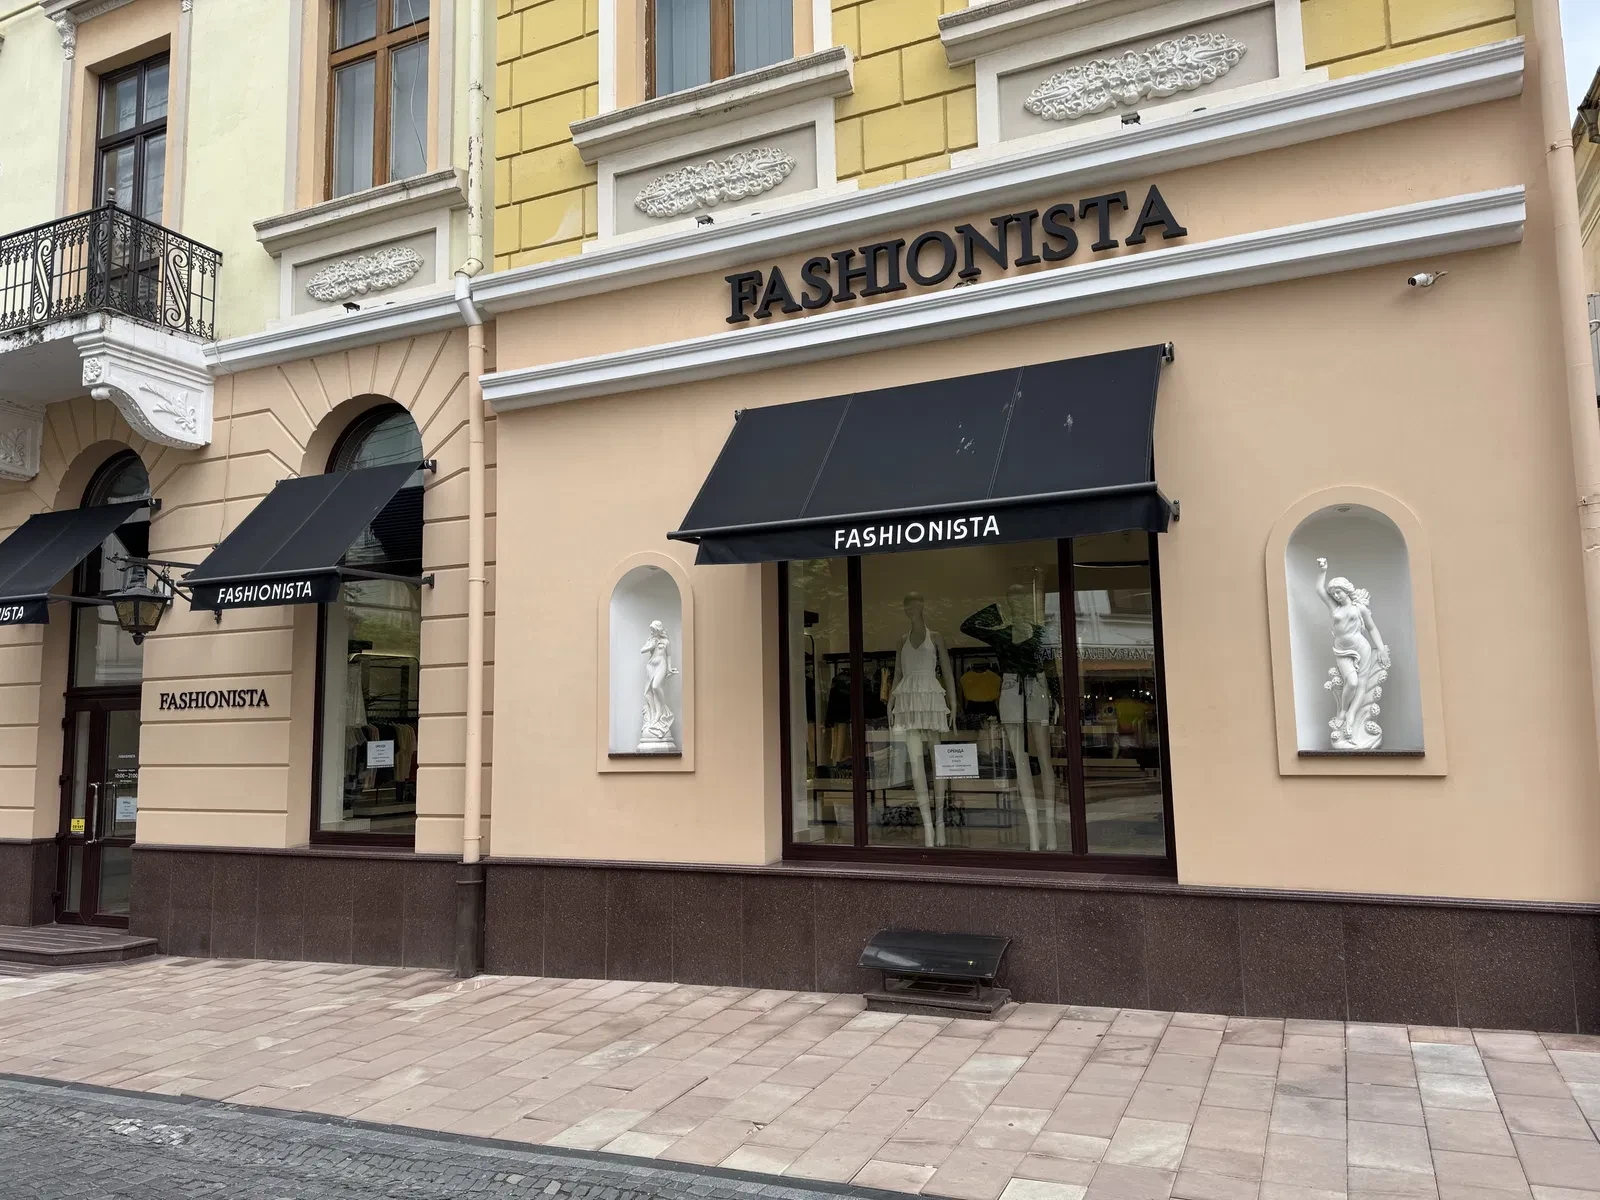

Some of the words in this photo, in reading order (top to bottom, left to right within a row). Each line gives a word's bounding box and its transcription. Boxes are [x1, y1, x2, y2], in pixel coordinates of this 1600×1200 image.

[725, 184, 1187, 323] FASHIONISTA
[834, 515, 1000, 550] FASHIONISTA
[217, 581, 312, 604] FASHIONISTA
[0, 606, 24, 621] ISTA
[159, 689, 269, 710] FASHIONISTA
